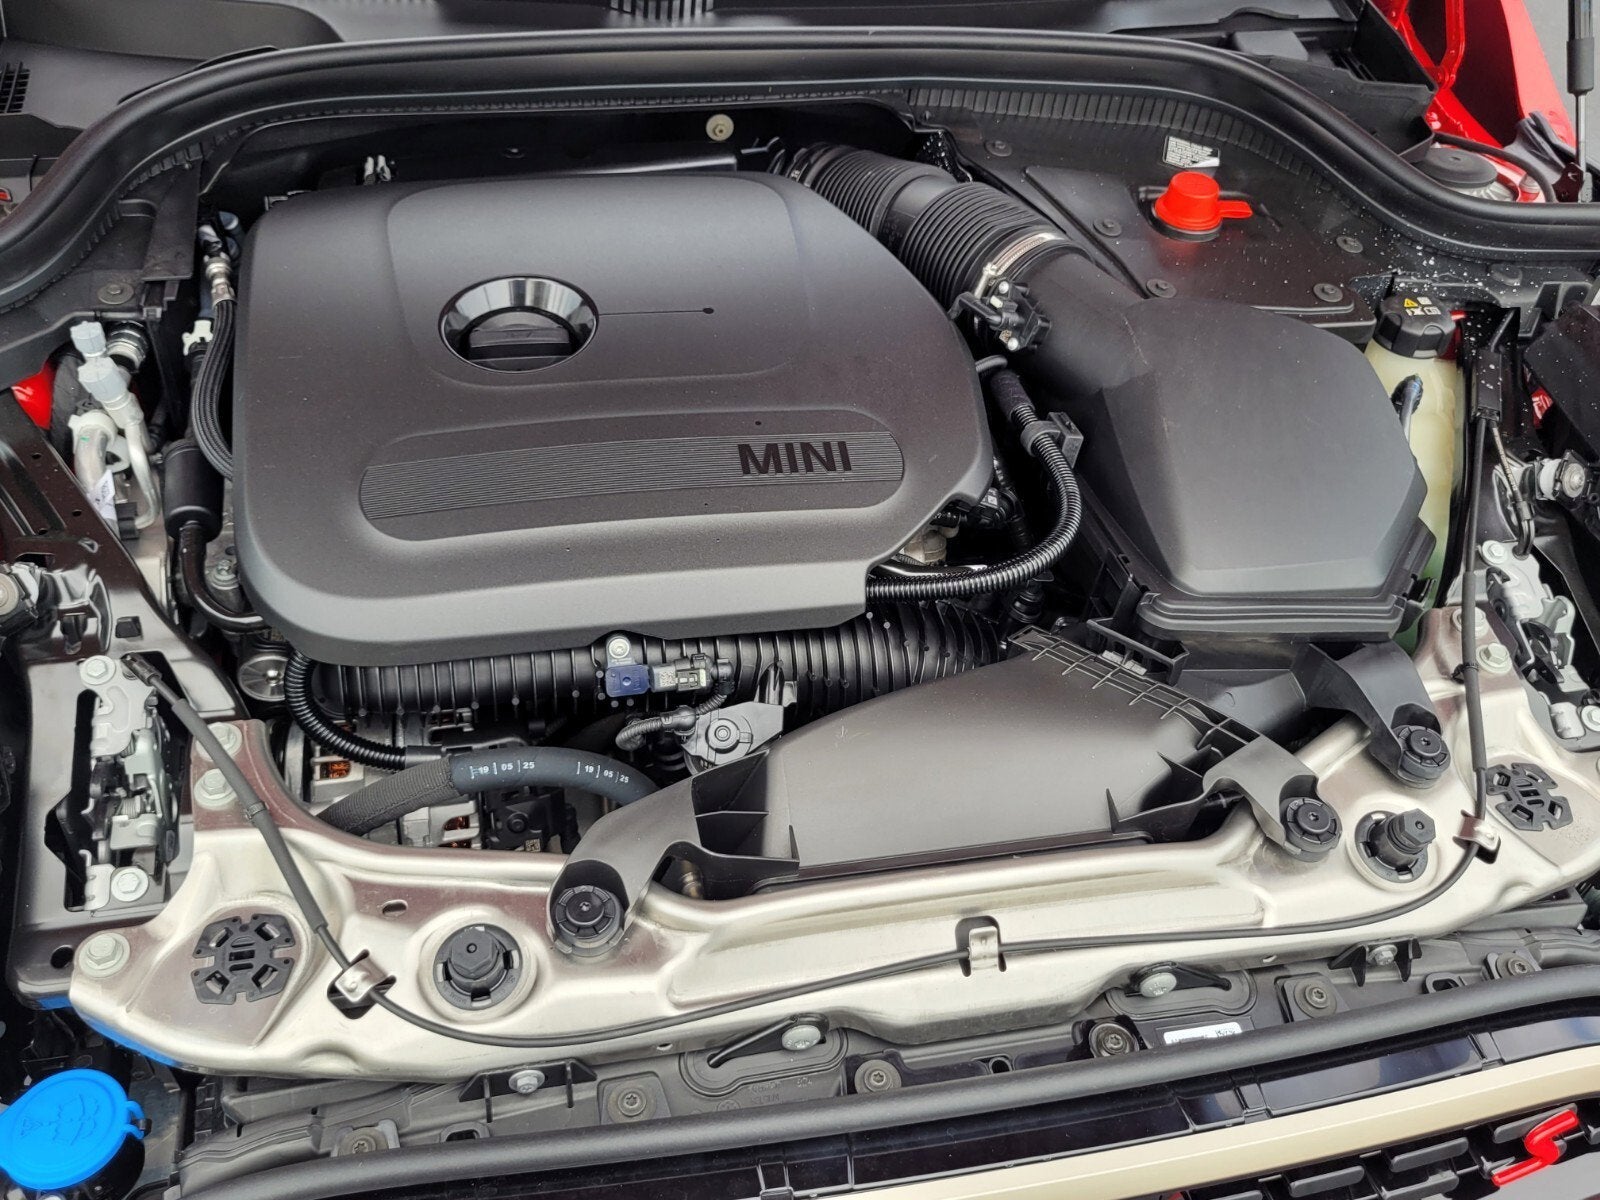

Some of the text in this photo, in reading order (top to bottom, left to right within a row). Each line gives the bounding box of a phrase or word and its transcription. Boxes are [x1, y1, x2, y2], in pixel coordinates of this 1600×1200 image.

[737, 440, 852, 475] MINI
[501, 762, 514, 771] 05
[522, 761, 535, 769] 25
[584, 764, 630, 783] 19 05 25
